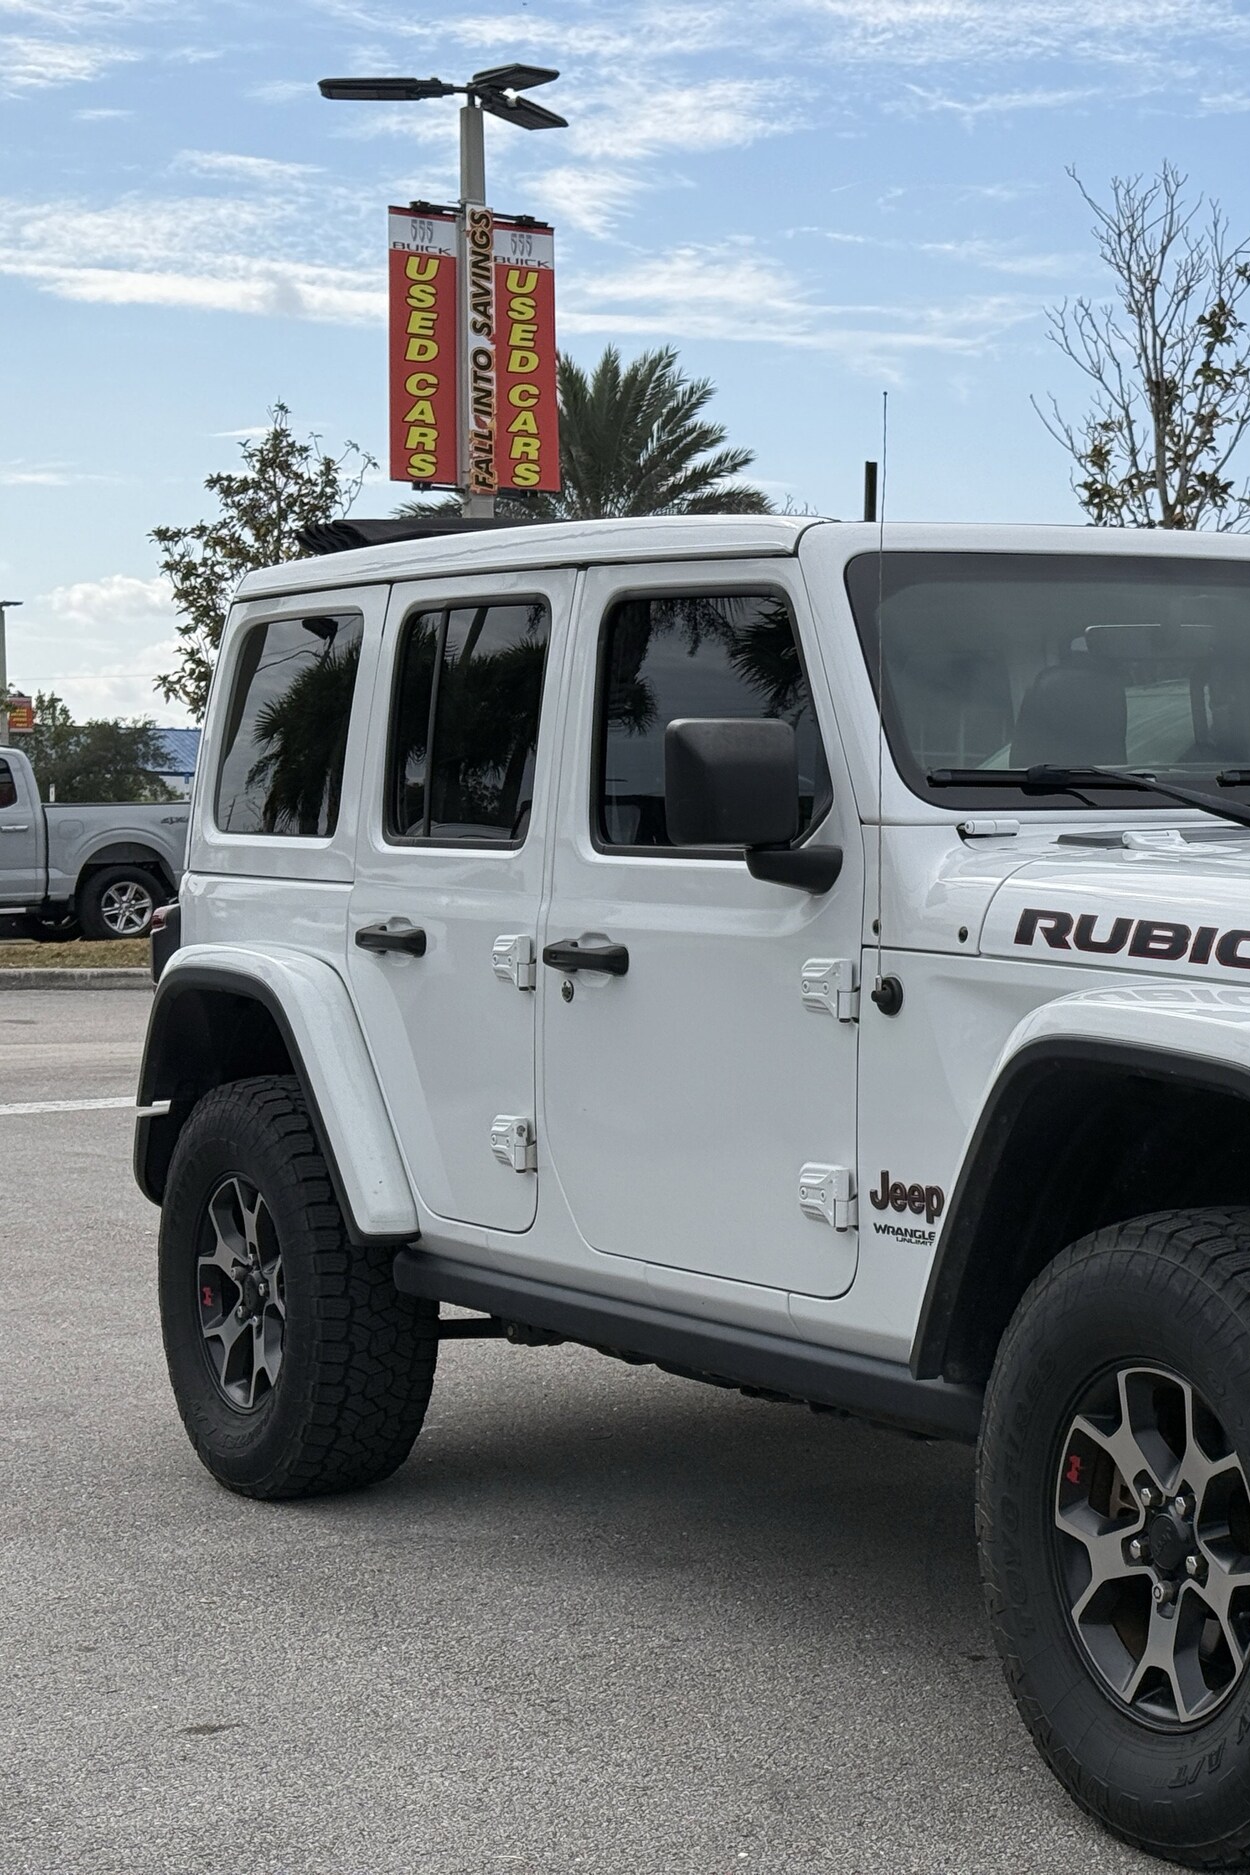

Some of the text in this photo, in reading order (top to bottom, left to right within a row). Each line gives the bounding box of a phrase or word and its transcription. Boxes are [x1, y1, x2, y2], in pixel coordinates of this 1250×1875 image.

[392, 241, 452, 256] BUICK
[493, 255, 550, 268] BUICK
[402, 255, 440, 478] USED CARS
[469, 208, 497, 490] FALL INTO SAVINGS
[505, 269, 541, 487] USED CARS
[869, 1169, 945, 1225] Jeep
